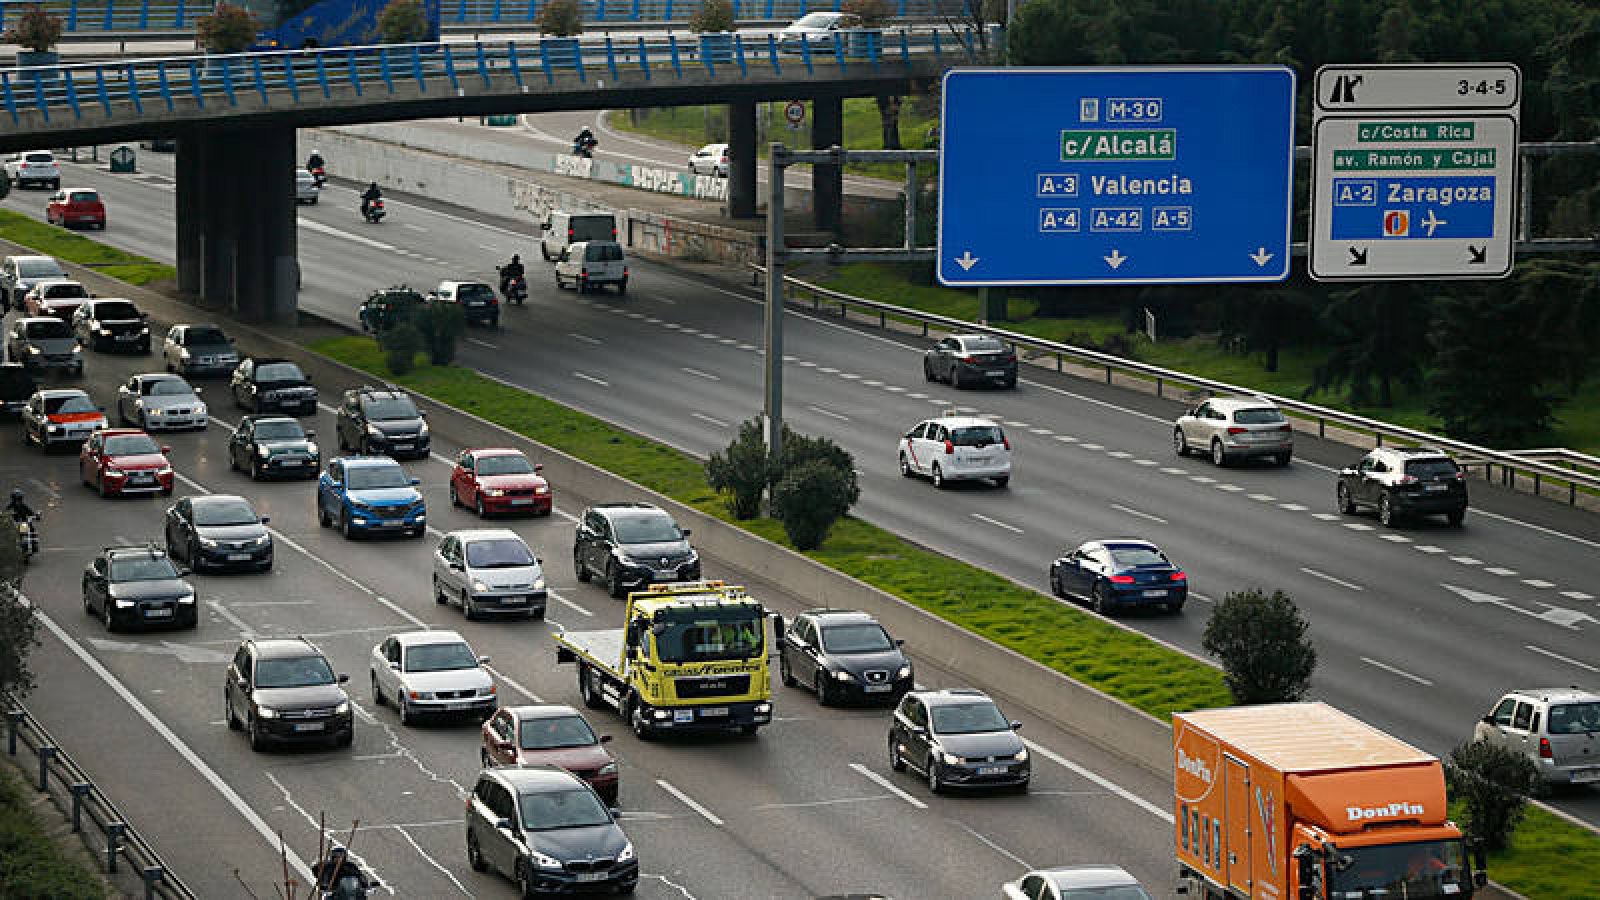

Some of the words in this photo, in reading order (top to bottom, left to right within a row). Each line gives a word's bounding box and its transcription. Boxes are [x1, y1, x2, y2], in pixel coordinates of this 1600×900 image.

[1457, 79, 1506, 95] 3-4-5
[1109, 102, 1159, 117] M-30
[1361, 125, 1427, 139] c/Costa
[1437, 125, 1471, 138] Rica
[1065, 135, 1171, 155] c/Alcalá
[1335, 156, 1359, 167] av.
[1367, 151, 1423, 166] Ramón
[1433, 155, 1441, 168] y
[1451, 151, 1493, 167] Cajal
[1041, 177, 1075, 193] A-3
[1091, 175, 1192, 195] Valencia
[1339, 185, 1373, 201] A-2
[1387, 183, 1491, 205] Zaragoza
[1043, 211, 1077, 227] A-4
[1094, 211, 1139, 227] A-42
[1155, 210, 1188, 226] A-5
[1346, 802, 1425, 821] DonPin
